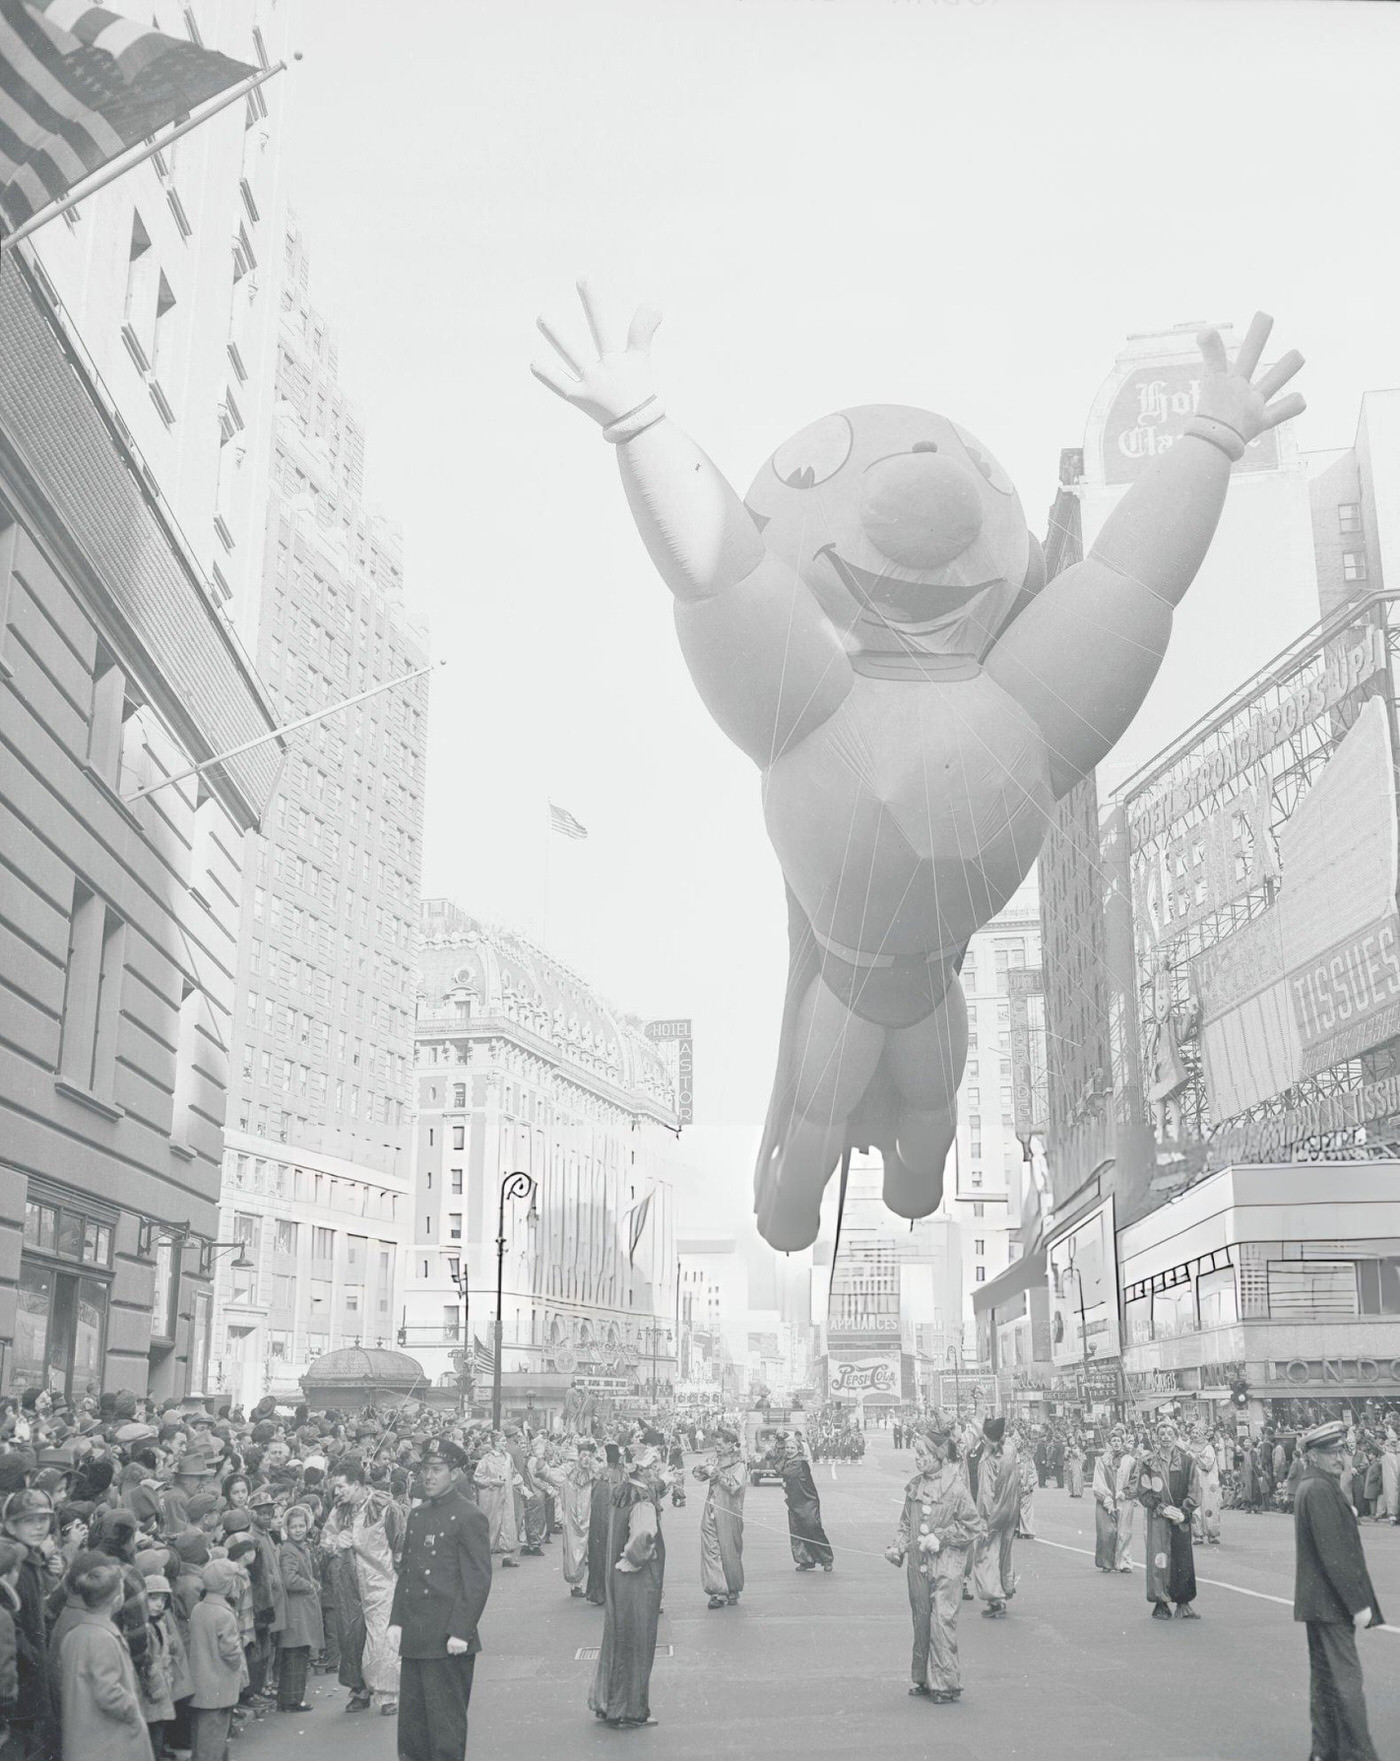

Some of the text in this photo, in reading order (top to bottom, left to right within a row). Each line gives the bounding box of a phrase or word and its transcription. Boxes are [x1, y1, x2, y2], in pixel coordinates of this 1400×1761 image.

[1269, 671, 1327, 748] POPS
[1335, 632, 1377, 700] UP!
[1293, 926, 1400, 1039] TISSUES
[652, 1022, 692, 1036] HOTEL
[679, 1043, 692, 1120] ASTOR
[830, 1319, 898, 1331] APPLIANCES
